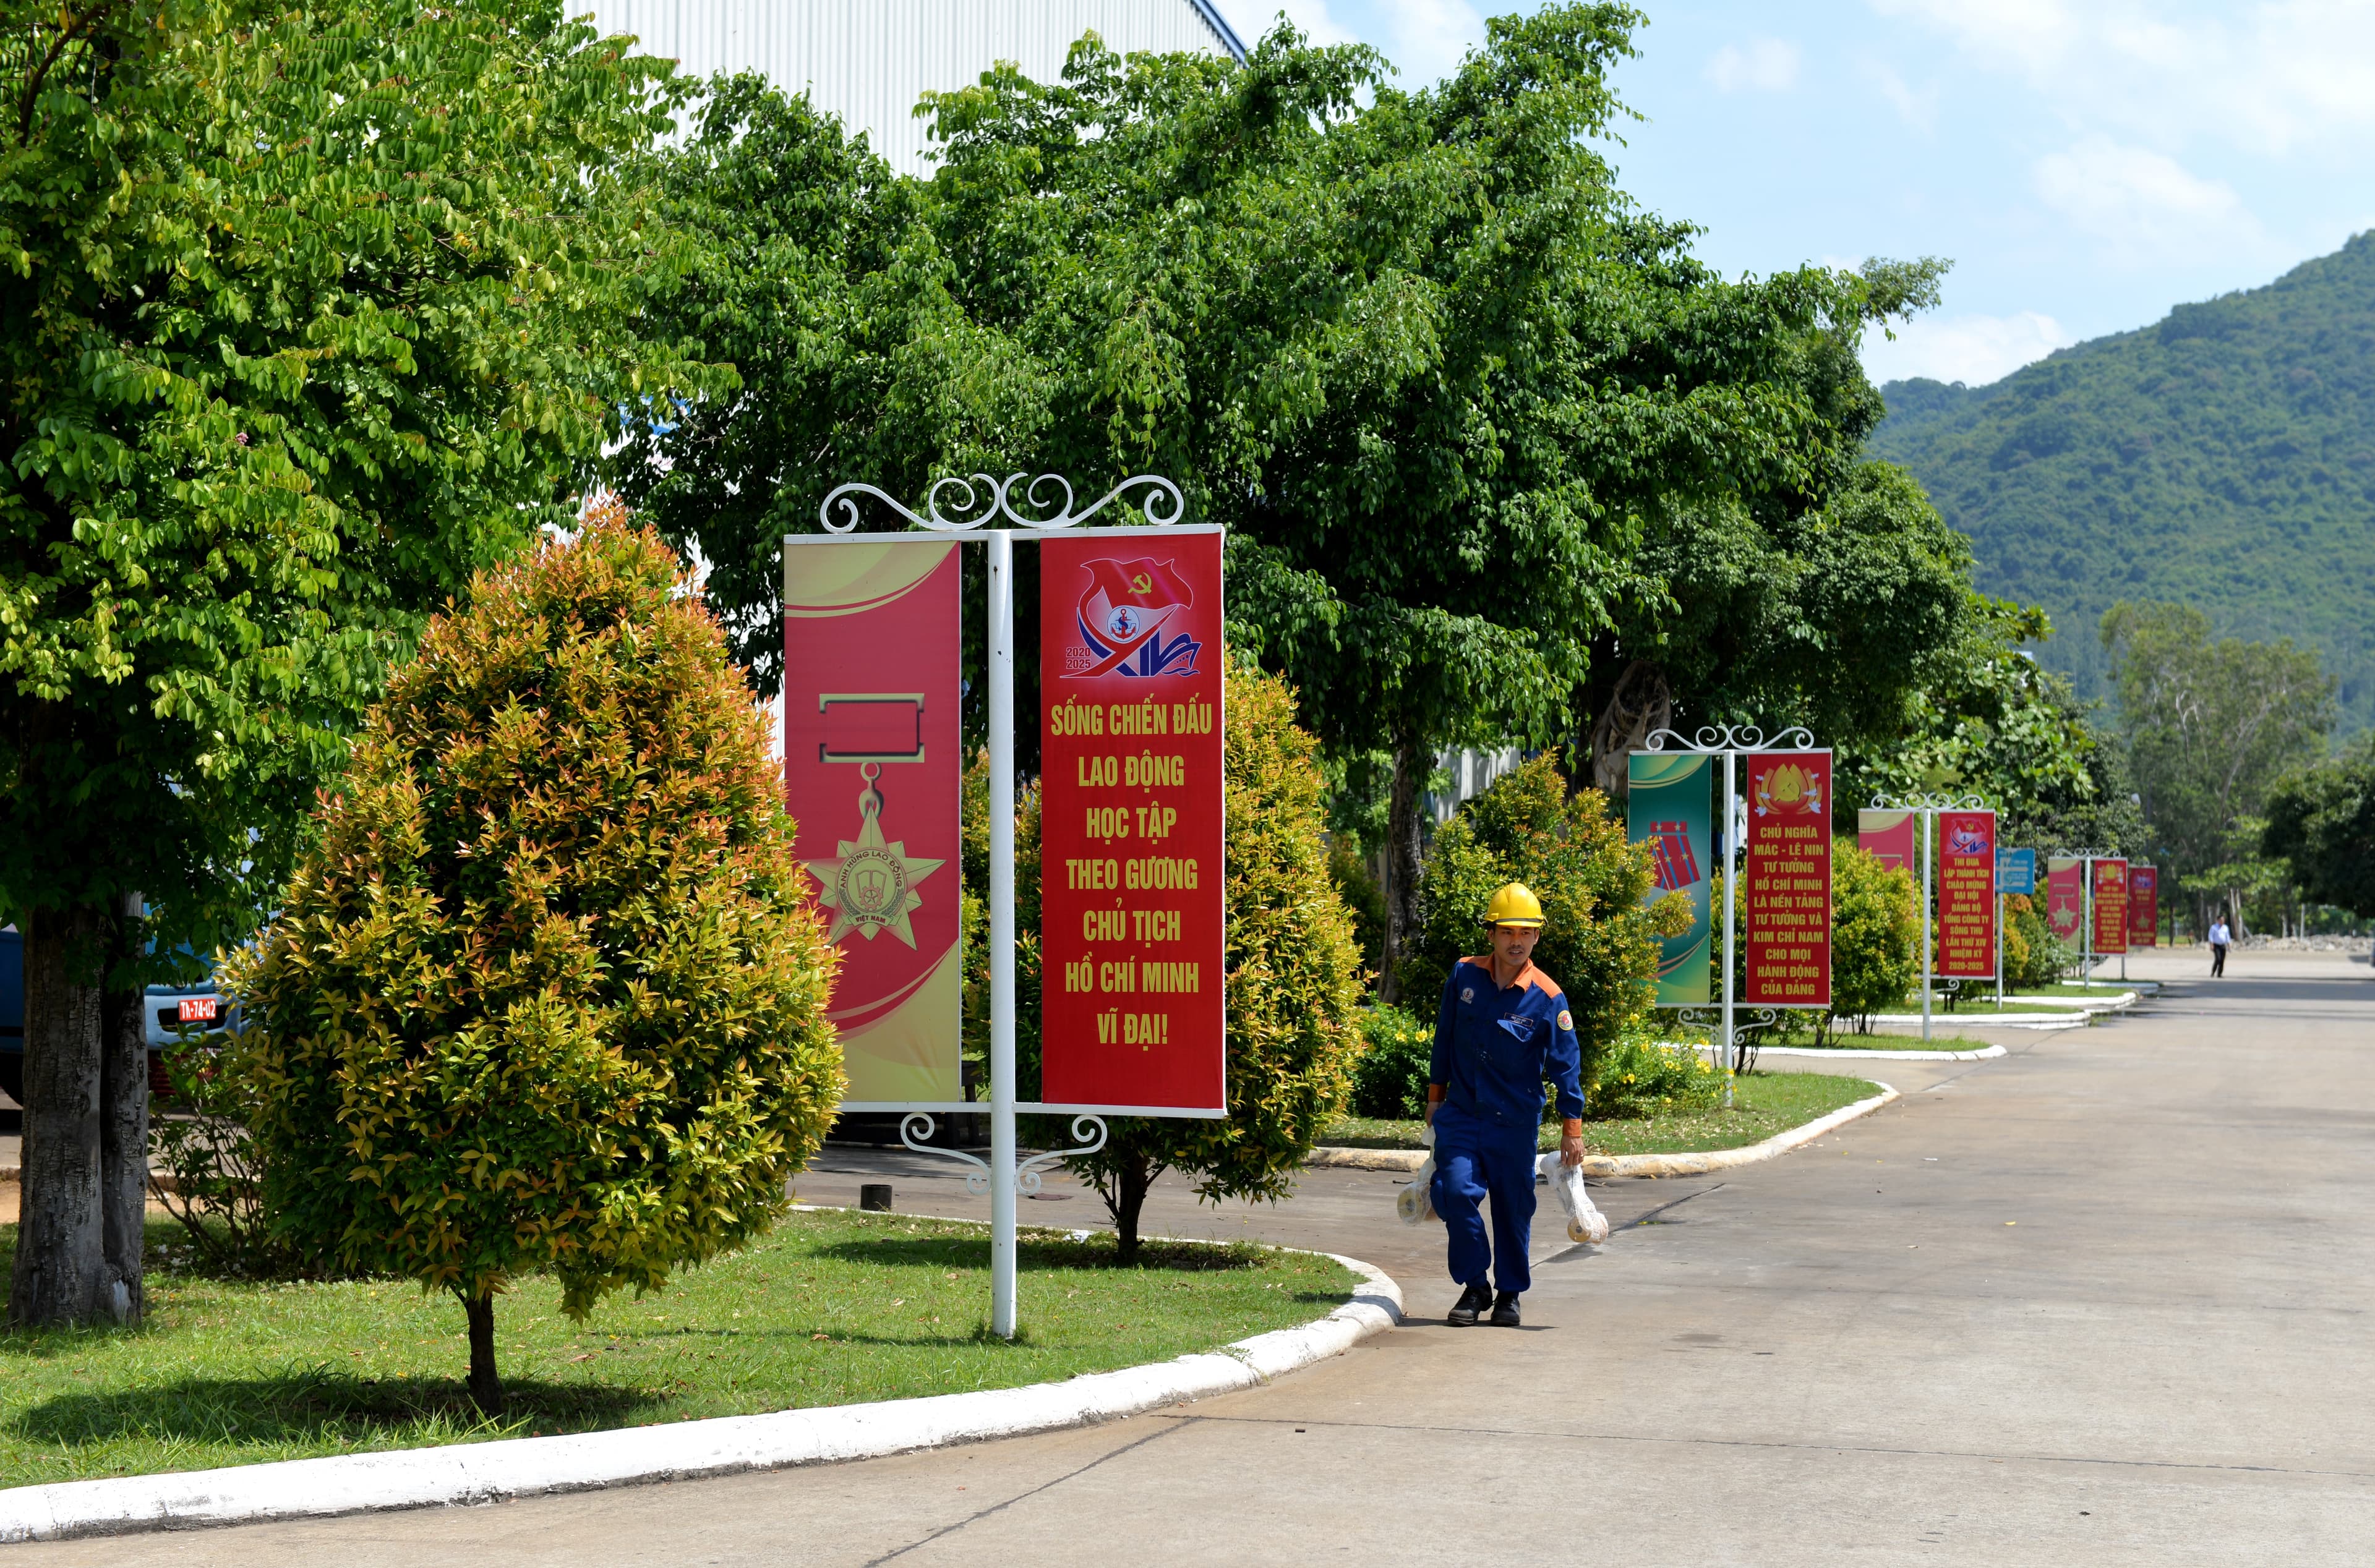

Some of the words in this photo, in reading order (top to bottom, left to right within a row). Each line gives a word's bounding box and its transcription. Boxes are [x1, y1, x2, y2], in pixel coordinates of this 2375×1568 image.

[1066, 647, 1090, 657] 2020
[1066, 659, 1090, 668] 2025
[1051, 694, 1103, 735] SỐNG
[1110, 693, 1166, 735] CHIẾN
[1173, 692, 1212, 734] ĐẤU
[1079, 756, 1118, 786] LAO
[1124, 749, 1184, 793] ĐỘNG
[1087, 807, 1129, 845] HỌC
[1136, 801, 1176, 845] TẬP
[1760, 822, 1781, 838] CHỦ
[1784, 825, 1818, 838] NGHĨA
[1754, 842, 1778, 856] MÁC
[1789, 842, 1801, 856] LÊ
[1804, 844, 1824, 856] NIN
[841, 869, 849, 888] ANH
[847, 851, 870, 868] HÙNG
[872, 851, 888, 860] LAO
[889, 860, 902, 887] ĐỘNG
[1066, 859, 1118, 889] THEO
[1126, 856, 1197, 890] GƯƠNG
[1763, 861, 1778, 873] TƯ
[1779, 858, 1814, 873] TƯỞNG
[1773, 877, 1791, 890] CHÍ
[1794, 879, 1822, 890] MINH
[1754, 894, 1767, 908] LÀ
[1795, 892, 1823, 908] TẢNG
[871, 915, 886, 923] NAM
[1084, 897, 1125, 940] CHỦ
[1132, 911, 1180, 948] TỊCH
[1755, 913, 1769, 925] TƯ
[1771, 910, 1805, 925] TƯỞNG
[1808, 912, 1823, 925] VÀ
[1982, 915, 1988, 924] TY
[1753, 931, 1774, 942] KIM
[1798, 931, 1823, 942] NAM
[1766, 948, 1787, 960] CHO
[1790, 948, 1811, 962] MỌI
[1066, 952, 1092, 992] HỒ
[1100, 955, 1135, 992] CHÍ
[1142, 963, 1199, 992] MINH
[1757, 964, 1786, 977] HÀNH
[1789, 964, 1820, 979] ĐỘNG
[1761, 979, 1782, 995] CỦA
[1785, 979, 1815, 995] ĐẢNG
[1097, 1007, 1117, 1044] VĨ
[1124, 1013, 1167, 1050] ĐẠI!
